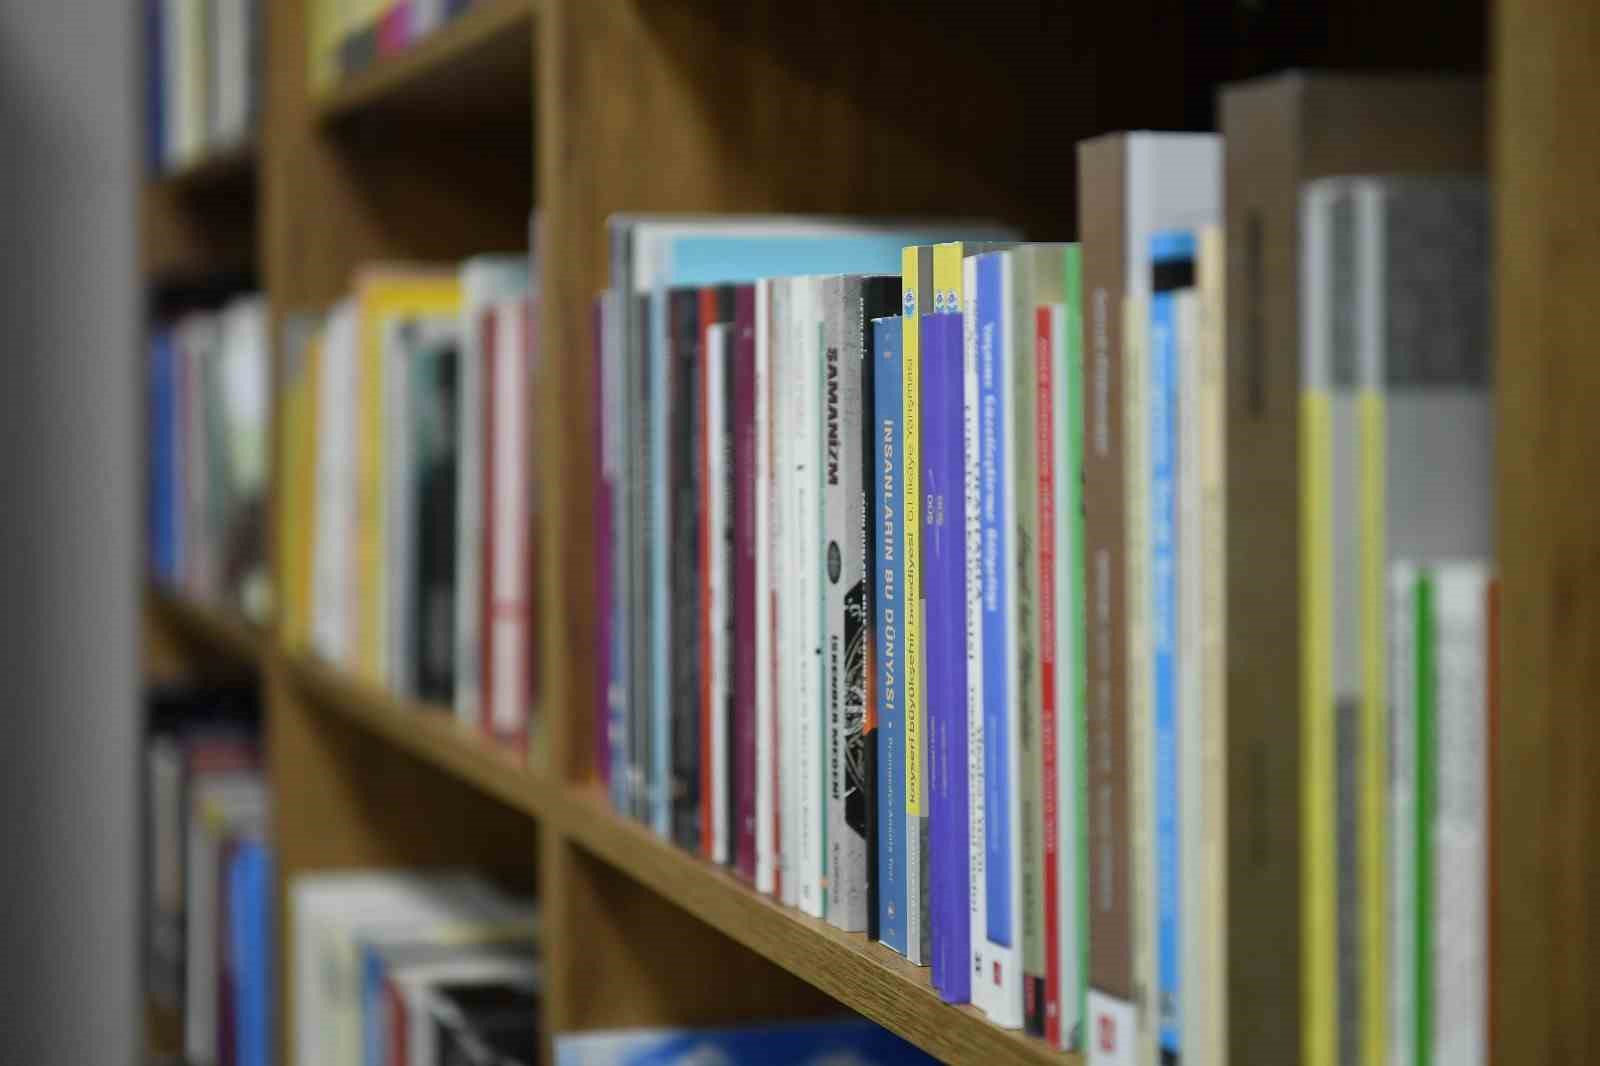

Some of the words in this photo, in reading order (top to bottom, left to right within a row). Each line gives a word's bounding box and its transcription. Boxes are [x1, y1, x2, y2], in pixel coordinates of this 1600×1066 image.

[884, 418, 896, 560] İNSANLARIN
[884, 567, 894, 600] BU
[907, 532, 915, 625] belediyesi
[885, 608, 896, 710] DÜNYASI
[908, 632, 916, 734] büyükşehir
[908, 737, 916, 803] kayseri
